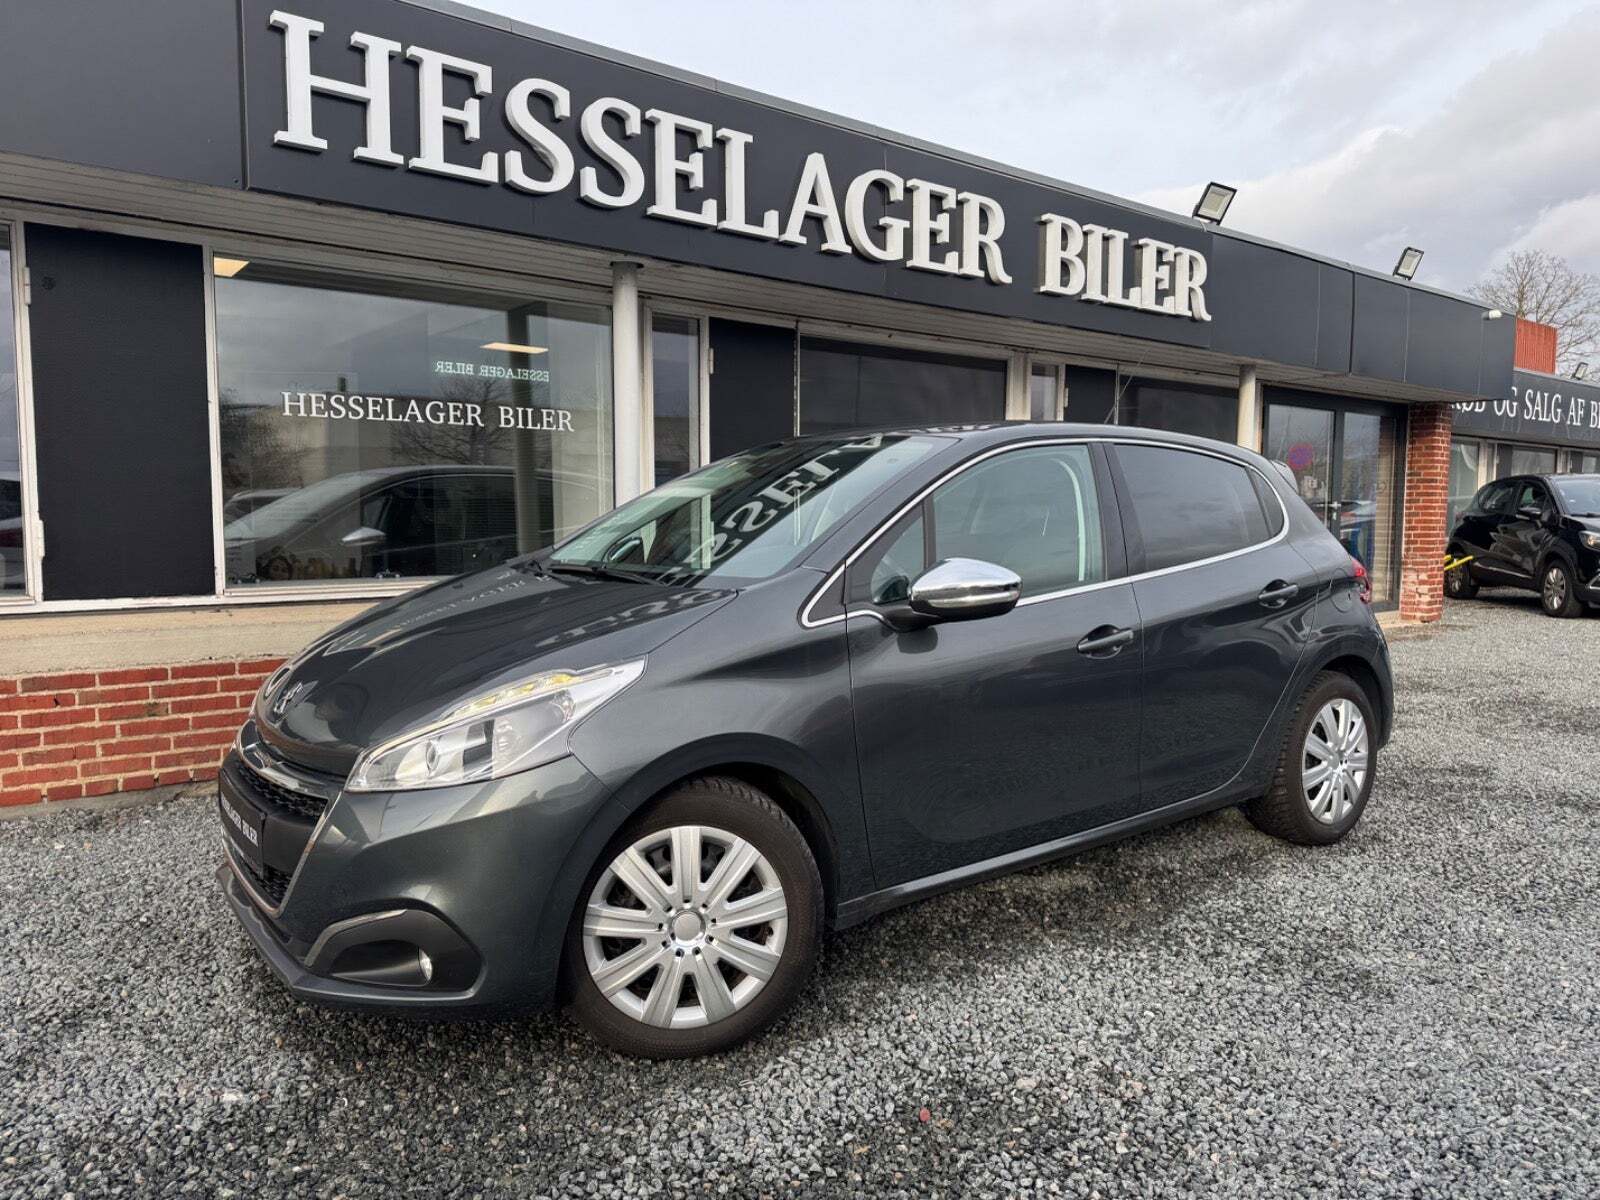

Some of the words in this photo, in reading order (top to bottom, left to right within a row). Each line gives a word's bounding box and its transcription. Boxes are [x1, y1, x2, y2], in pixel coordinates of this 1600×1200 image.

[269, 9, 1013, 285] HESSELAGER
[1038, 212, 1212, 322] BILER
[281, 391, 485, 427] HESSELAGER
[498, 405, 575, 433] BILER
[1524, 389, 1562, 423] SALG
[1566, 397, 1585, 426] AF
